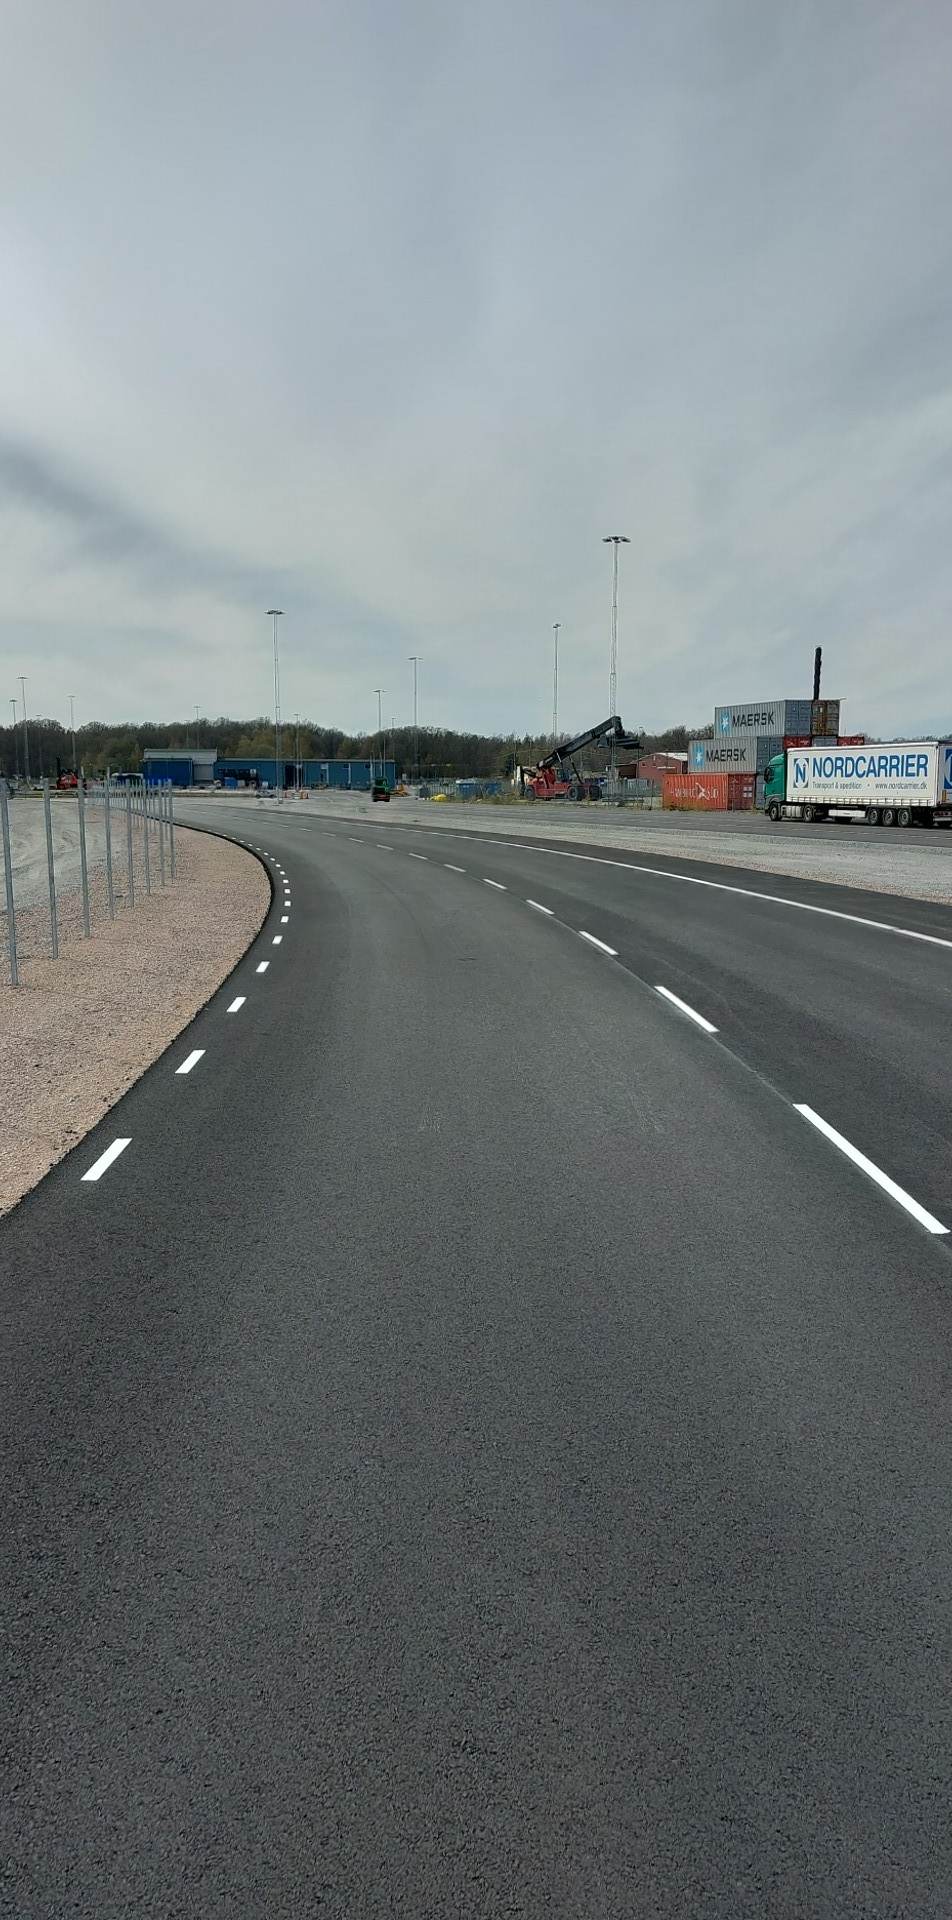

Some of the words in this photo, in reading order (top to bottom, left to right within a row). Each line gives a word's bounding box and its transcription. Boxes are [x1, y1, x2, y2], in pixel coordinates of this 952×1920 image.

[732, 712, 775, 727] MAERSK
[706, 748, 747, 762] MAERSK
[812, 754, 928, 778] NORDCARRIER
